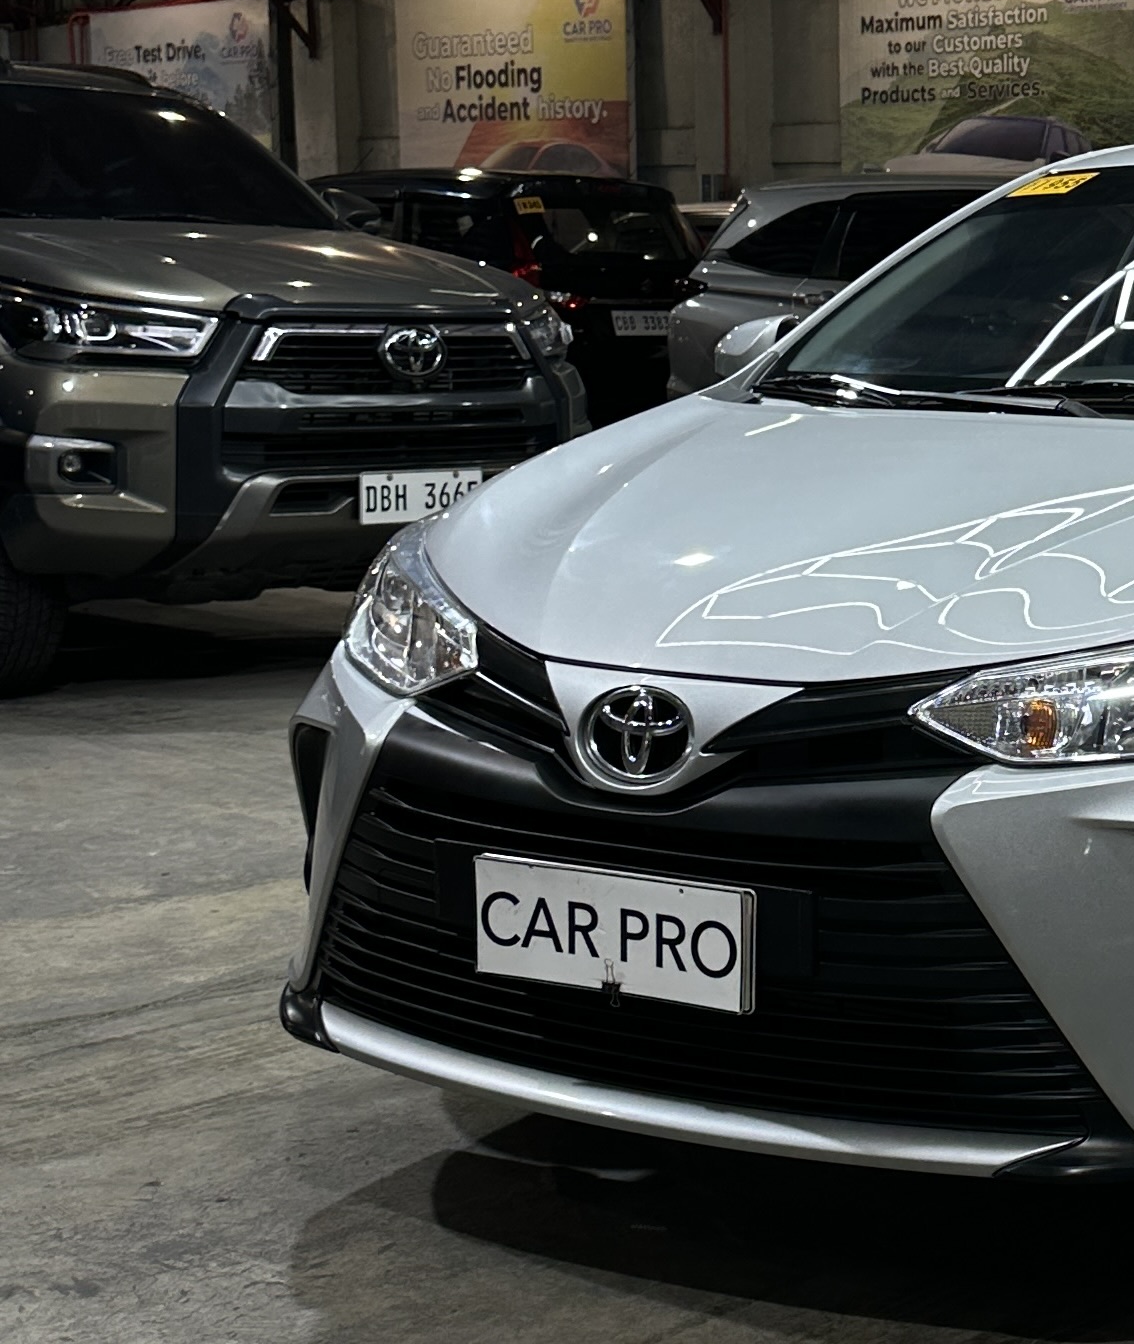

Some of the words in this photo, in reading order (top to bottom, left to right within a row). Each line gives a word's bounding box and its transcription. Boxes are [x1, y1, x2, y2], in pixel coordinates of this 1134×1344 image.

[563, 21, 587, 36] CAR
[588, 19, 613, 34] PRO
[861, 12, 942, 35] Maximum
[947, 3, 1048, 30] Satisfaction
[135, 45, 162, 63] Test
[165, 38, 206, 63] Drive,
[412, 24, 534, 59] Guaranteed
[888, 39, 902, 54] to
[905, 39, 927, 54] our
[932, 32, 1023, 54] Customers
[425, 66, 452, 92] No
[455, 60, 542, 93] Flooding
[871, 60, 899, 79] with
[902, 58, 925, 77] the
[928, 58, 965, 79] Best
[968, 54, 1031, 79] Quality
[861, 84, 936, 105] Products
[940, 85, 961, 99] and
[967, 79, 1046, 101] Services.
[417, 105, 441, 122] and
[442, 94, 531, 123] Accident
[537, 93, 608, 124] history.
[366, 484, 407, 513] DBH
[480, 891, 600, 958] CAR
[620, 908, 737, 978] PRO
